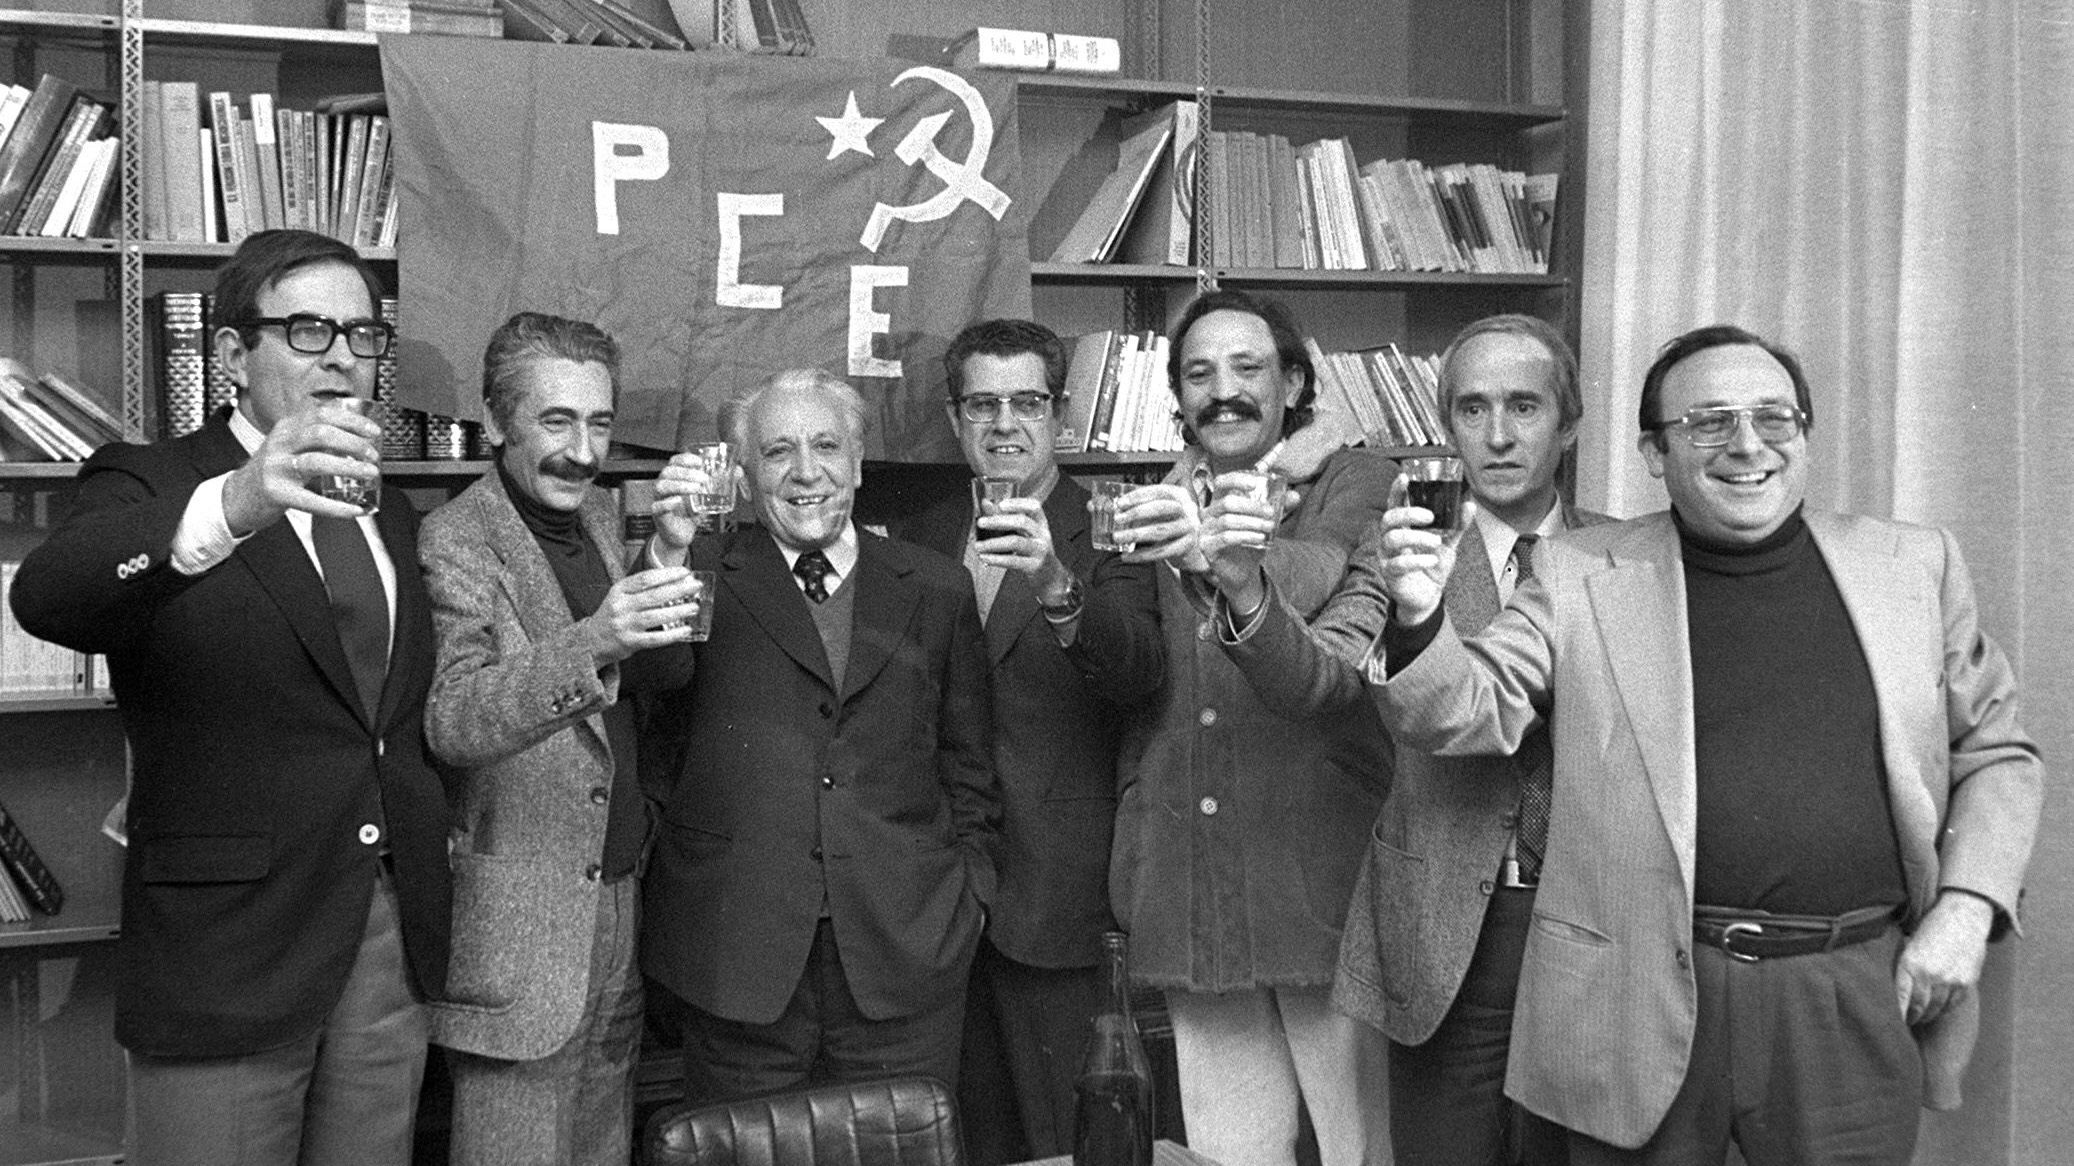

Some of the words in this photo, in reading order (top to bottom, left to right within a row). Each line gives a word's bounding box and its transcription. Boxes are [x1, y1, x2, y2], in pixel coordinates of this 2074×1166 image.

[592, 121, 670, 235] P
[716, 192, 783, 309] C
[848, 264, 909, 377] E
